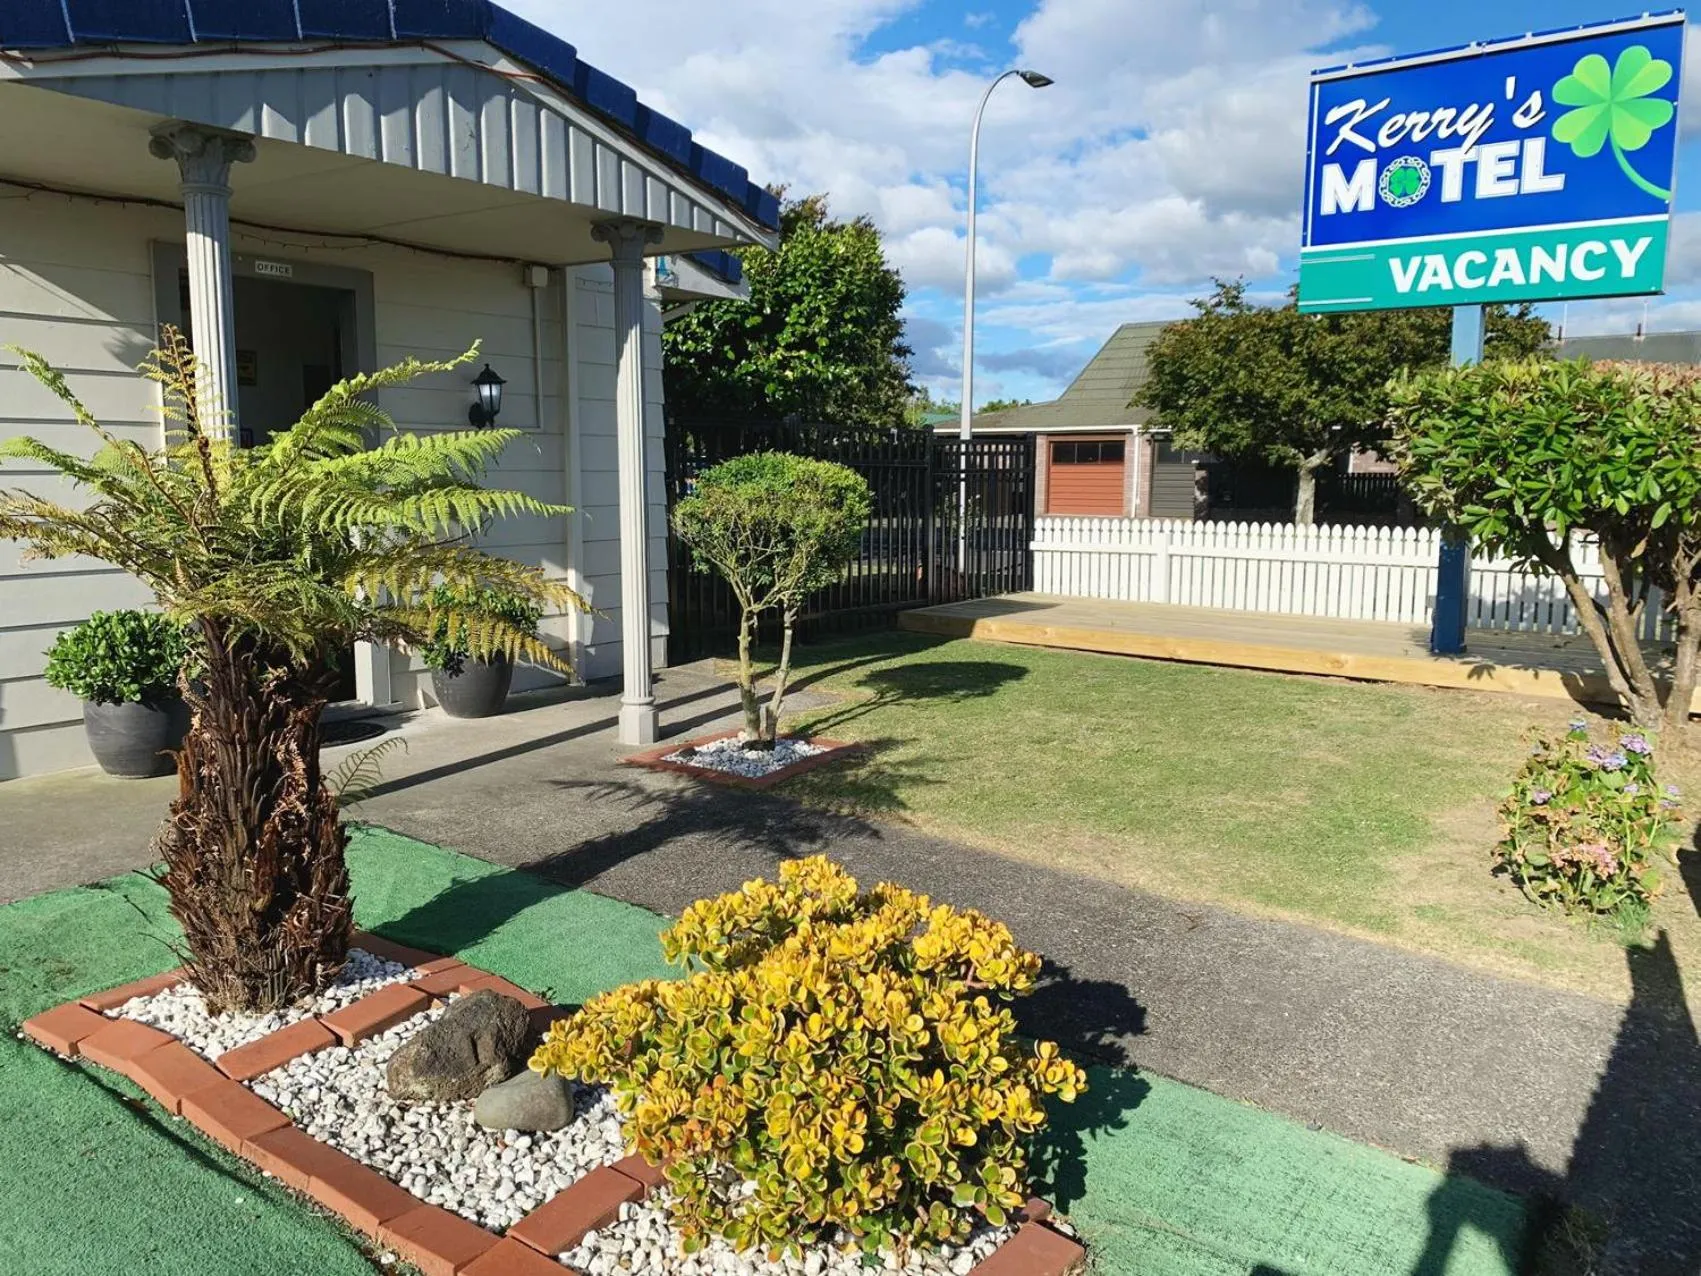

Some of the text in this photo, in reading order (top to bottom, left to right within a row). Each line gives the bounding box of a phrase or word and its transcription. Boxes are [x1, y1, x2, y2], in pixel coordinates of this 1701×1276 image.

[1324, 76, 1546, 156] Kerry's
[257, 263, 289, 273] OFFICE
[1388, 237, 1653, 292] VACANCY
